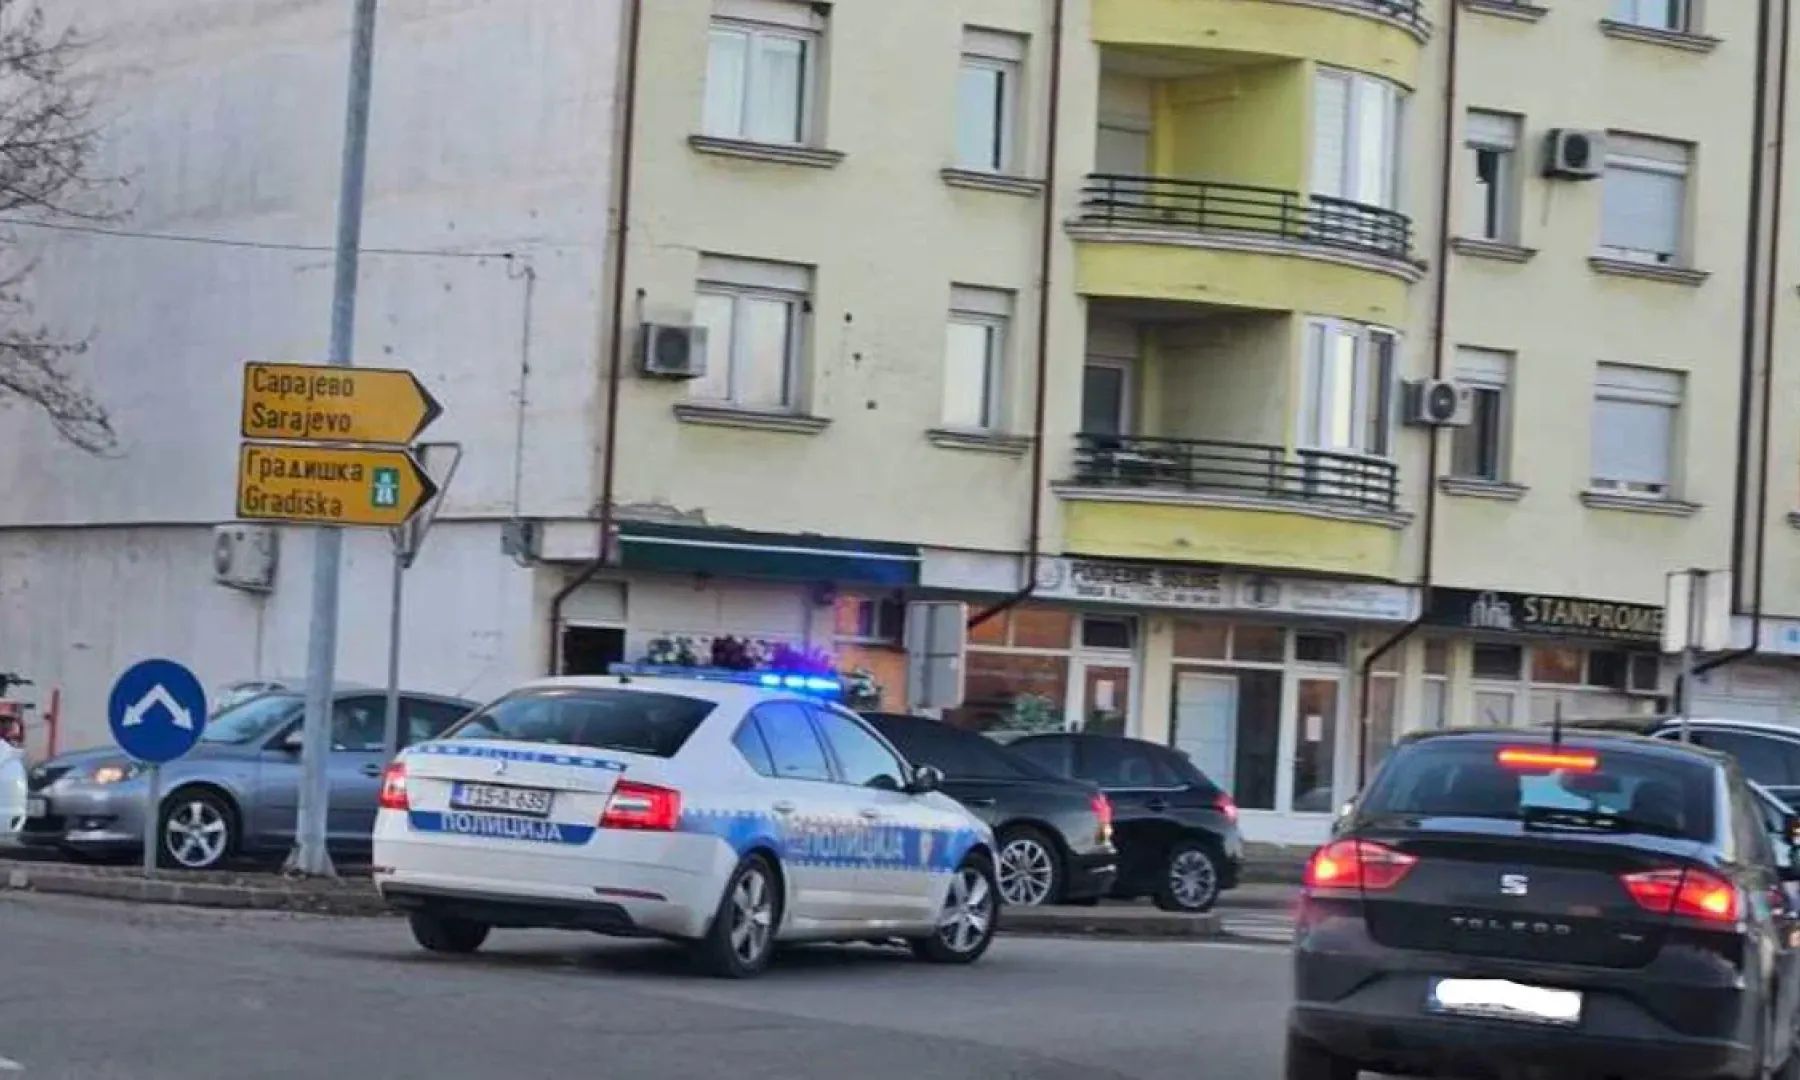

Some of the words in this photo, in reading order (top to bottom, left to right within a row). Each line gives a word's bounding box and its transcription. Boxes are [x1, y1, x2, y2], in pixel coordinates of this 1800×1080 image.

[253, 367, 355, 401] Сарајево
[251, 402, 353, 437] Sarajevo
[247, 450, 363, 482] Градишка
[244, 486, 343, 518] Gradiška
[442, 813, 562, 840] ПОЛИЦИЈА
